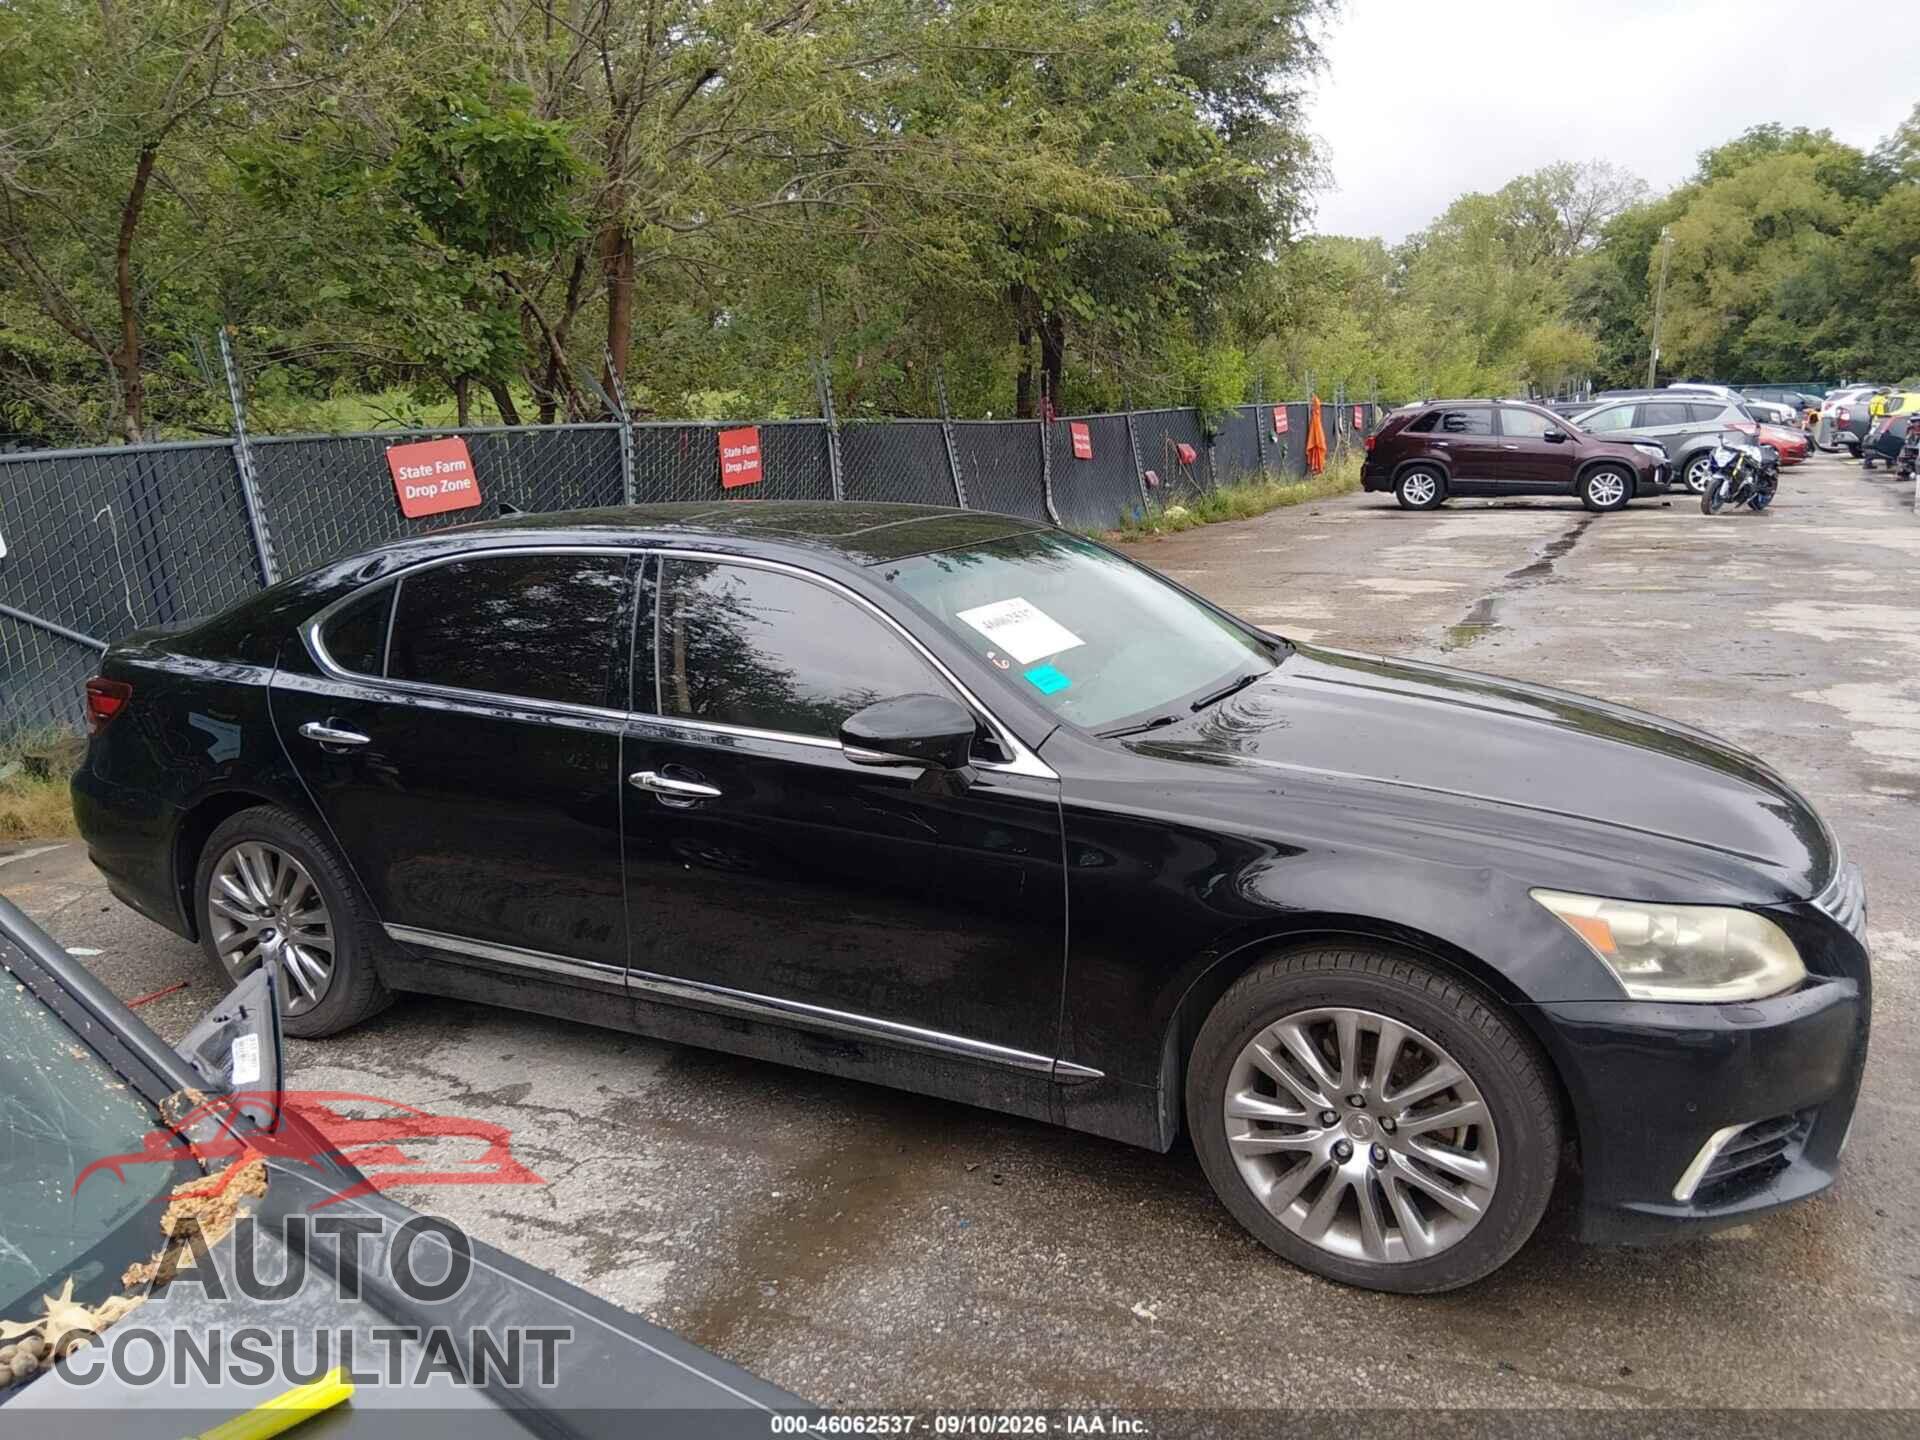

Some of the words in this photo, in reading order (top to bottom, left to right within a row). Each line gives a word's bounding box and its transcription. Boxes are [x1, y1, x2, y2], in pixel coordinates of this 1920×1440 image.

[399, 464, 433, 480] State
[435, 460, 466, 474] Farm
[405, 484, 437, 499] Drop
[440, 479, 471, 493] Zone
